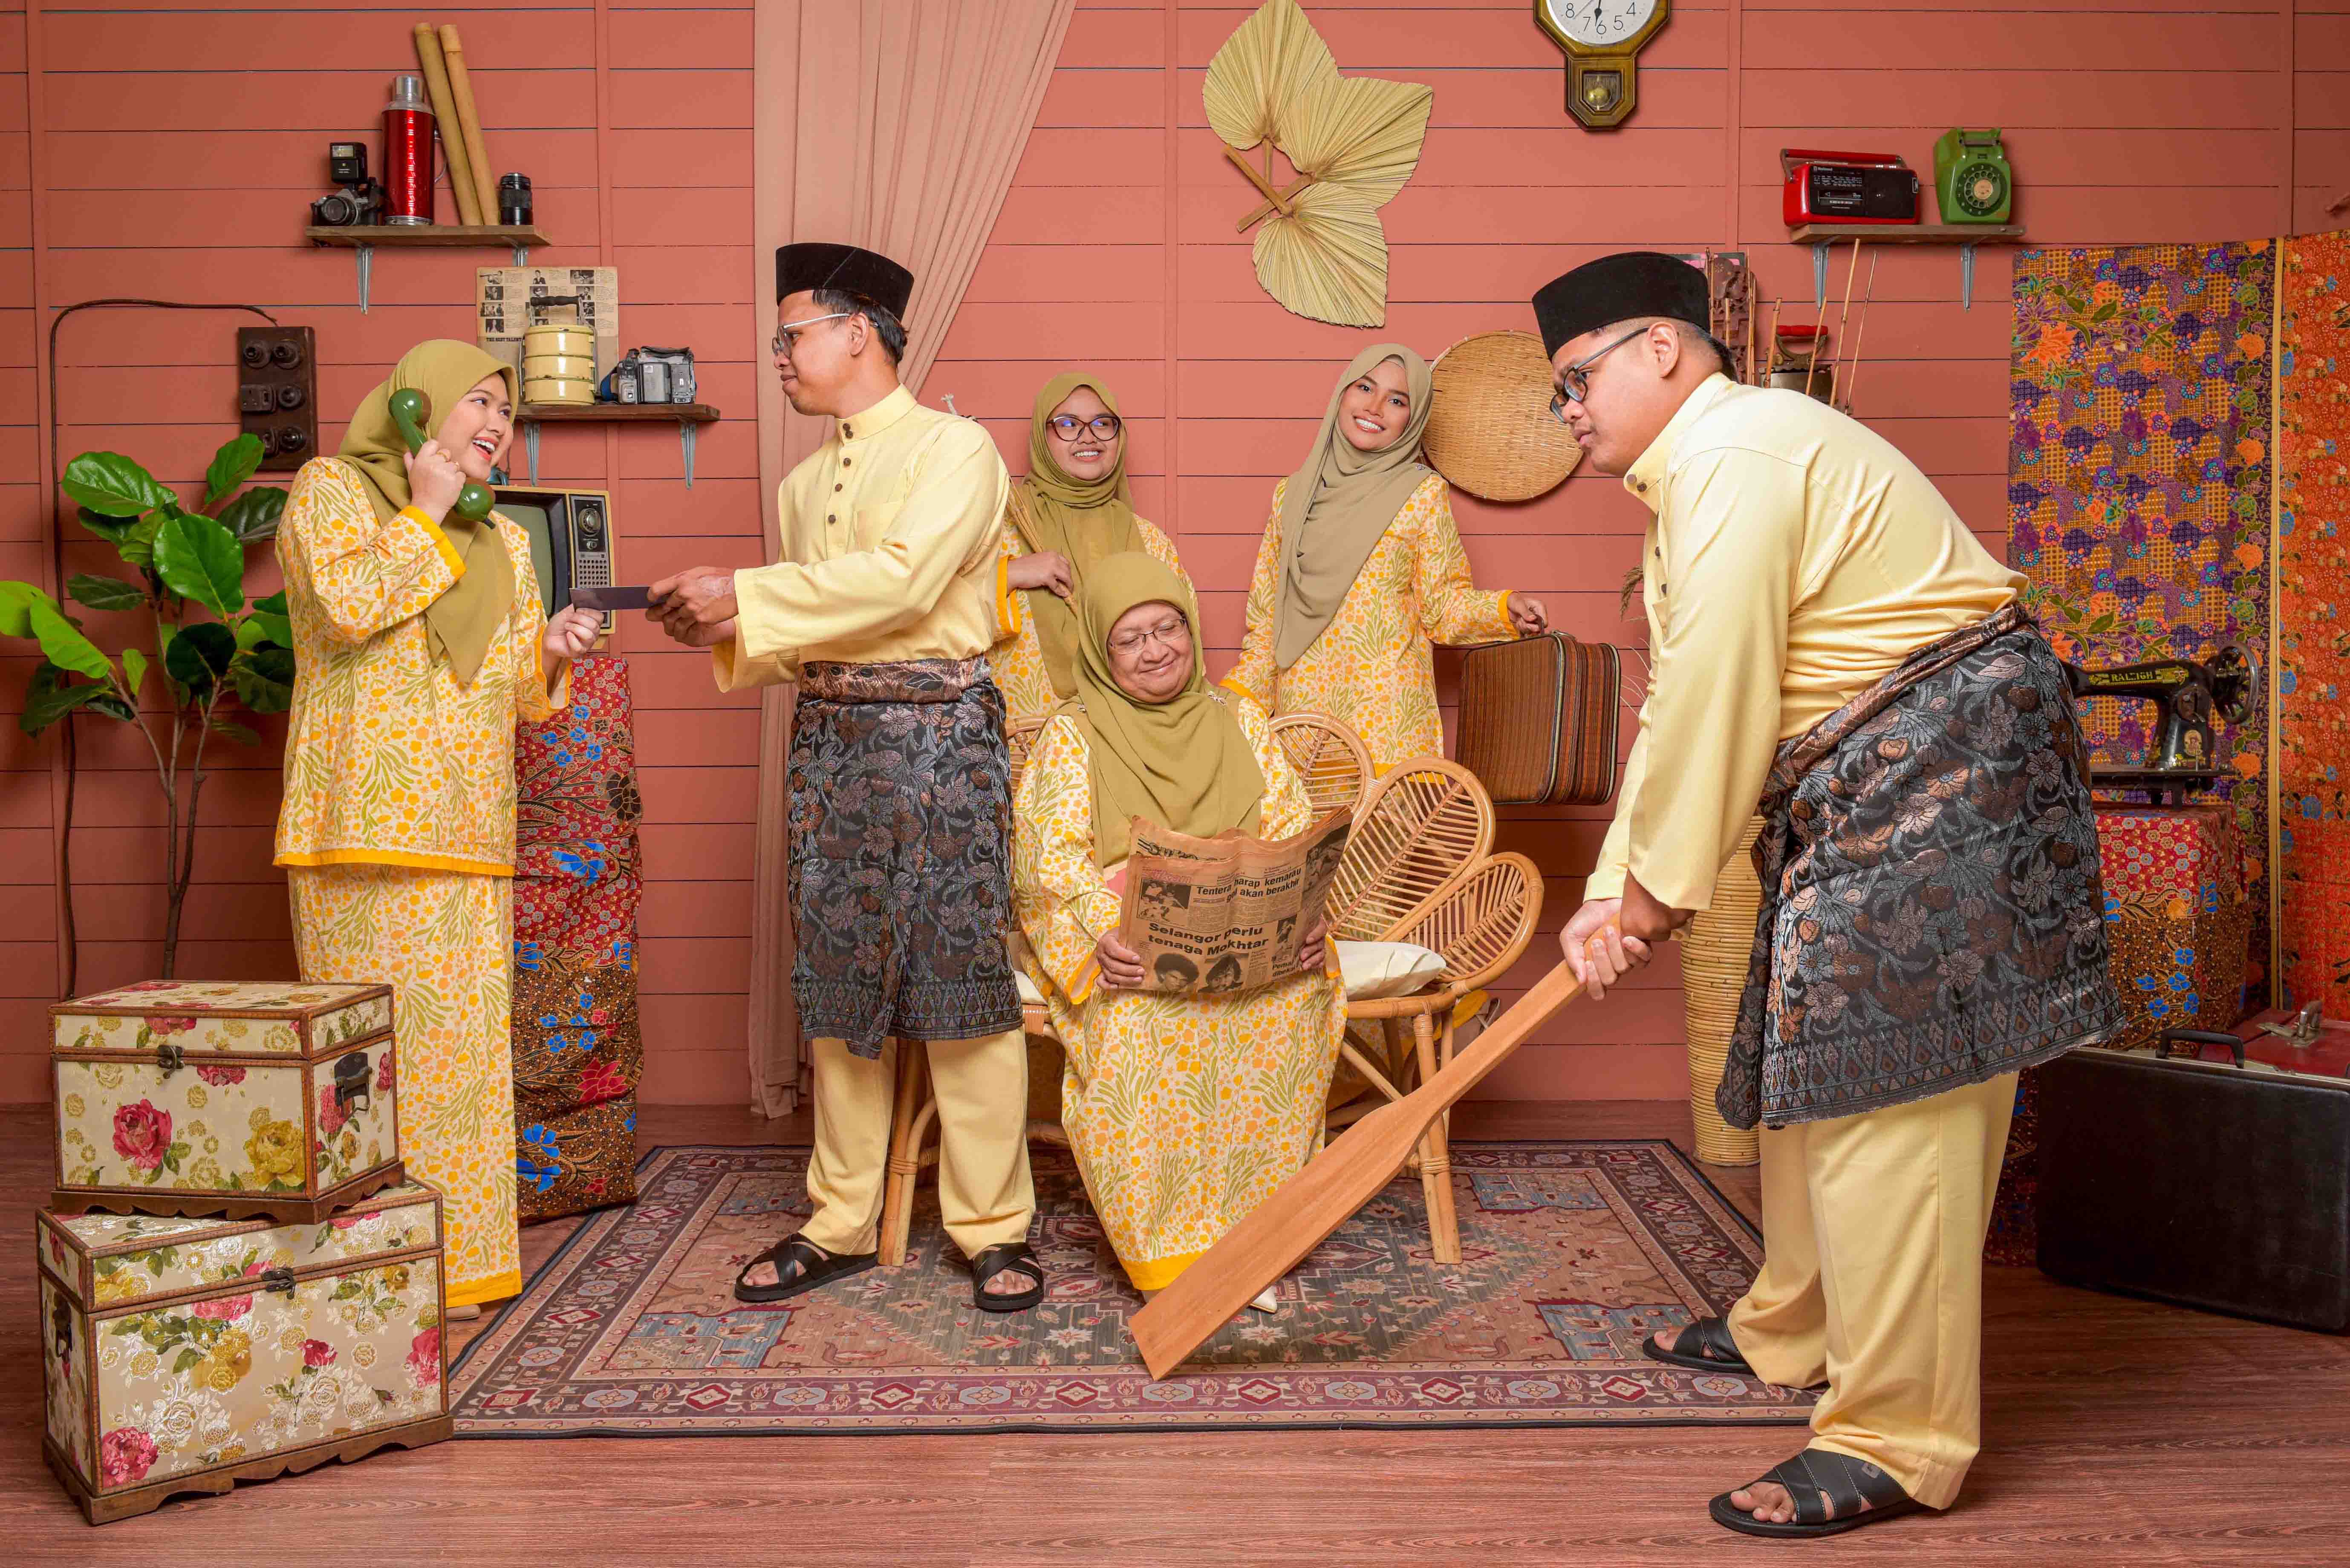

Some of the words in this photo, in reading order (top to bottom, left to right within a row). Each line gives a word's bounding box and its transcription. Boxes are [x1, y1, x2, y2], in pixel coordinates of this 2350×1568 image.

[1565, 3, 1575, 18] 8
[1626, 2, 1636, 16] 4
[1582, 17, 1591, 31] 7
[1596, 20, 1606, 35] 6
[1613, 15, 1623, 30] 5
[1196, 885, 1232, 895] Tentera
[1264, 868, 1301, 886] kemarau
[1240, 888, 1263, 897] akan
[1266, 879, 1299, 896] berakhir
[1149, 922, 1221, 943] Selangor
[1224, 927, 1263, 940] perlu
[1148, 934, 1203, 955] tenaga
[1207, 939, 1269, 955] Mokhtar
